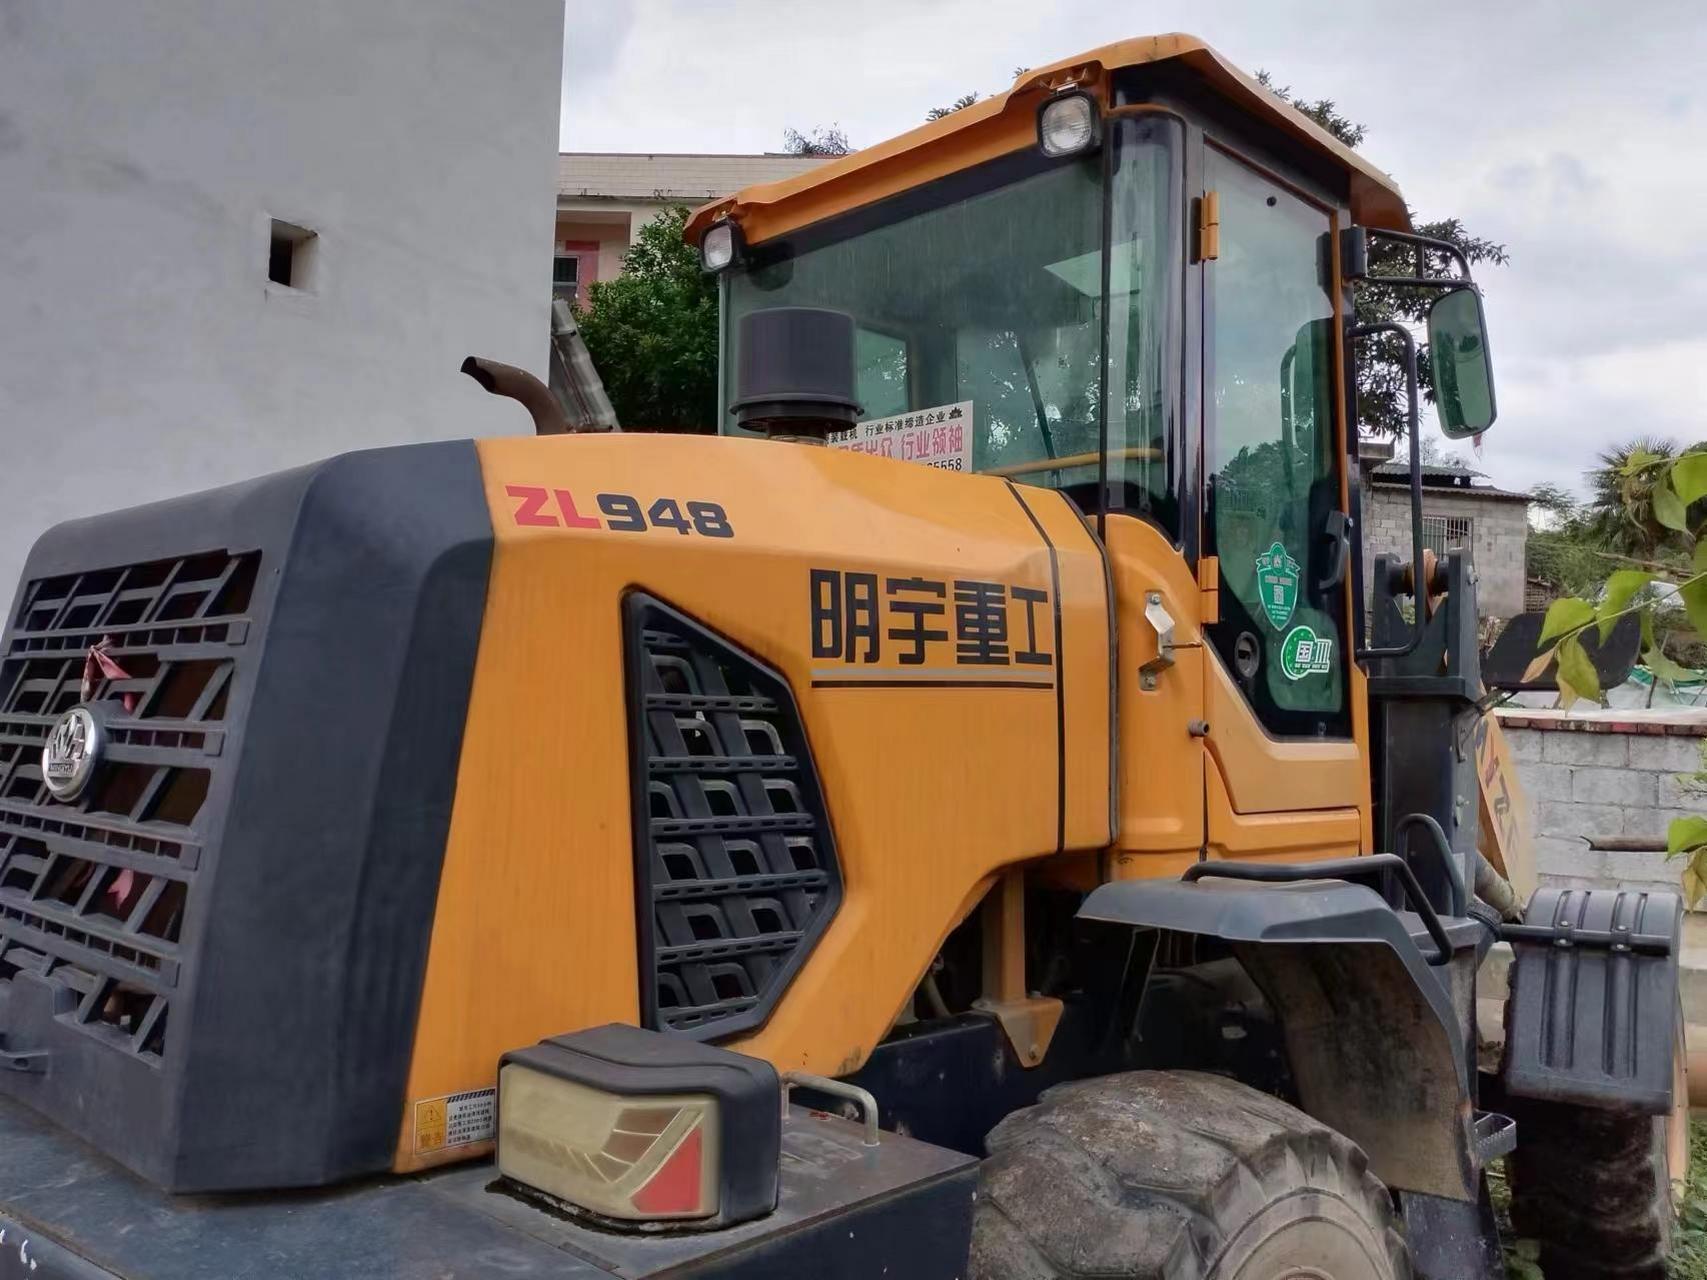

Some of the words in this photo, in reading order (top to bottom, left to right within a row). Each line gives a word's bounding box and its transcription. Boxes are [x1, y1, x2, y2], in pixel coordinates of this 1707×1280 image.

[865, 411, 946, 437] 行业标准缔造企业
[898, 424, 963, 460] 行业领袖
[927, 457, 963, 472] 5558
[505, 485, 735, 538] ZL948
[810, 568, 1053, 666] 明宇重工
